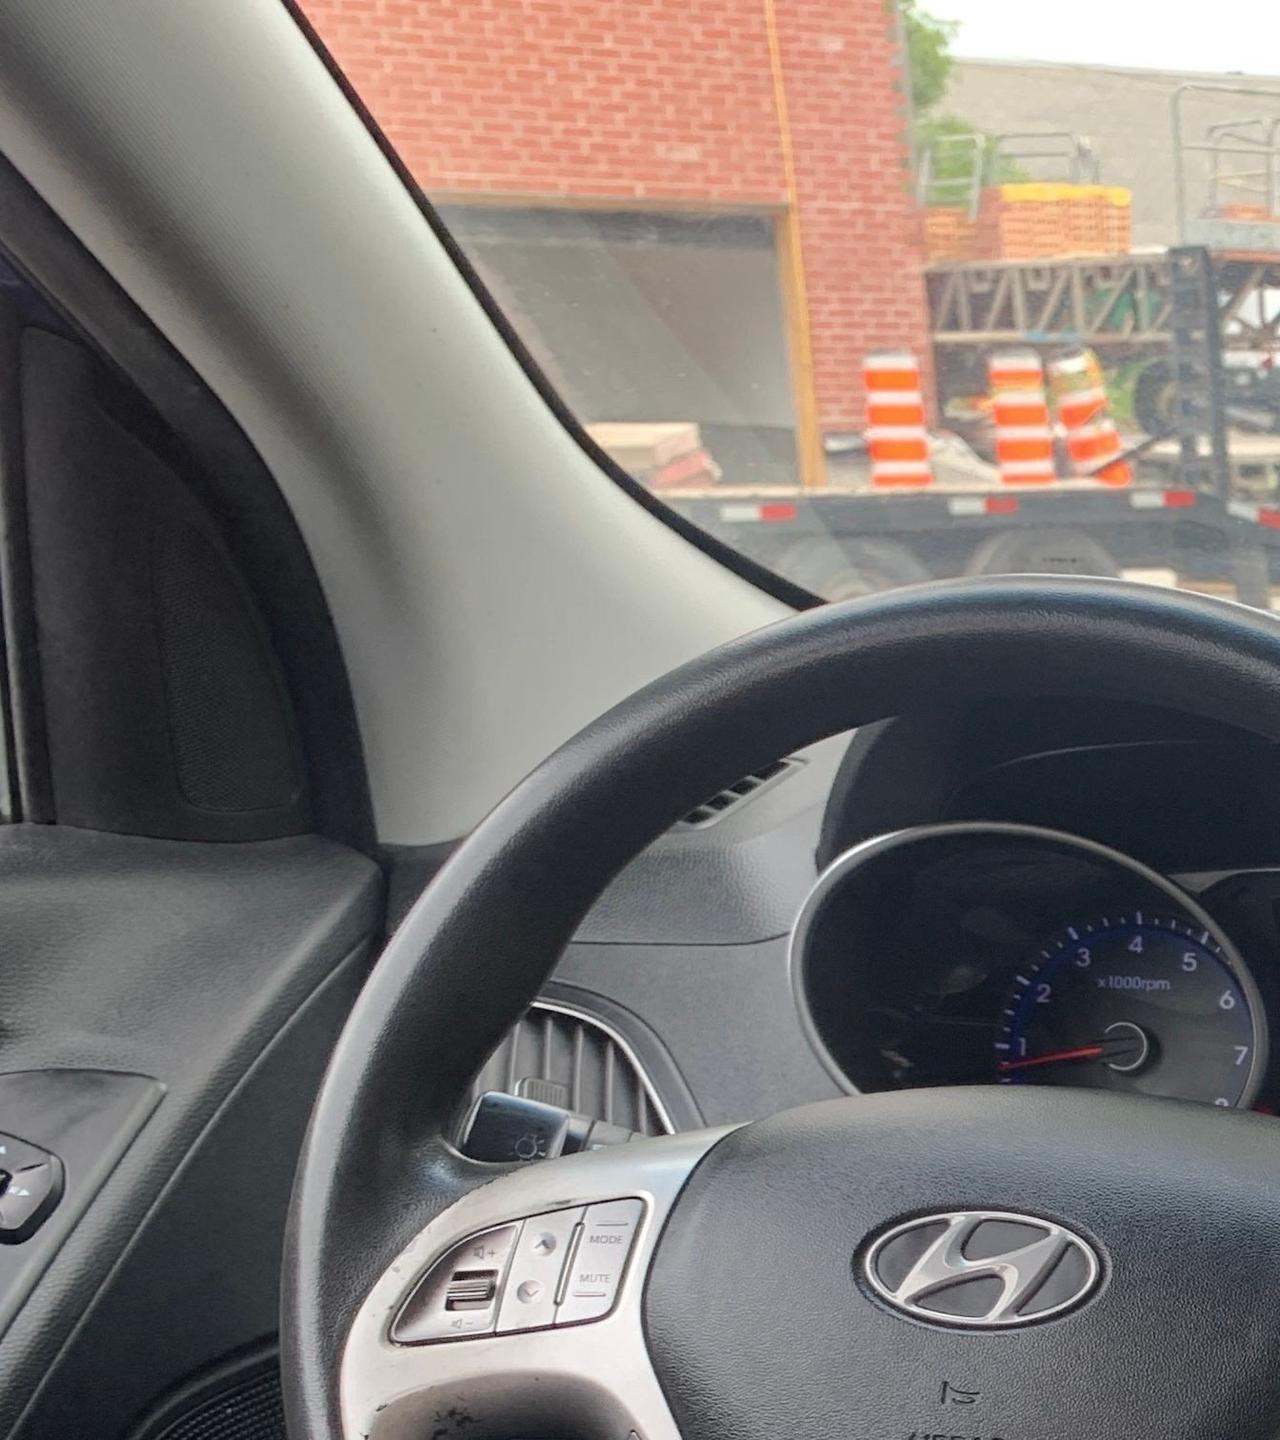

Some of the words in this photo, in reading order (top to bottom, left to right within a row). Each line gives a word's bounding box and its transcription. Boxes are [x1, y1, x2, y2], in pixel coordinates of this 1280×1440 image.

[1129, 936, 1142, 953] 4
[1076, 949, 1090, 967] 3
[1182, 953, 1197, 971] 5
[1037, 984, 1050, 1003] 2
[1220, 990, 1235, 1009] 6
[1019, 1037, 1026, 1056] 1
[1234, 1047, 1248, 1065] 7
[589, 1235, 623, 1244] MODE
[580, 1274, 611, 1283] MUTE
